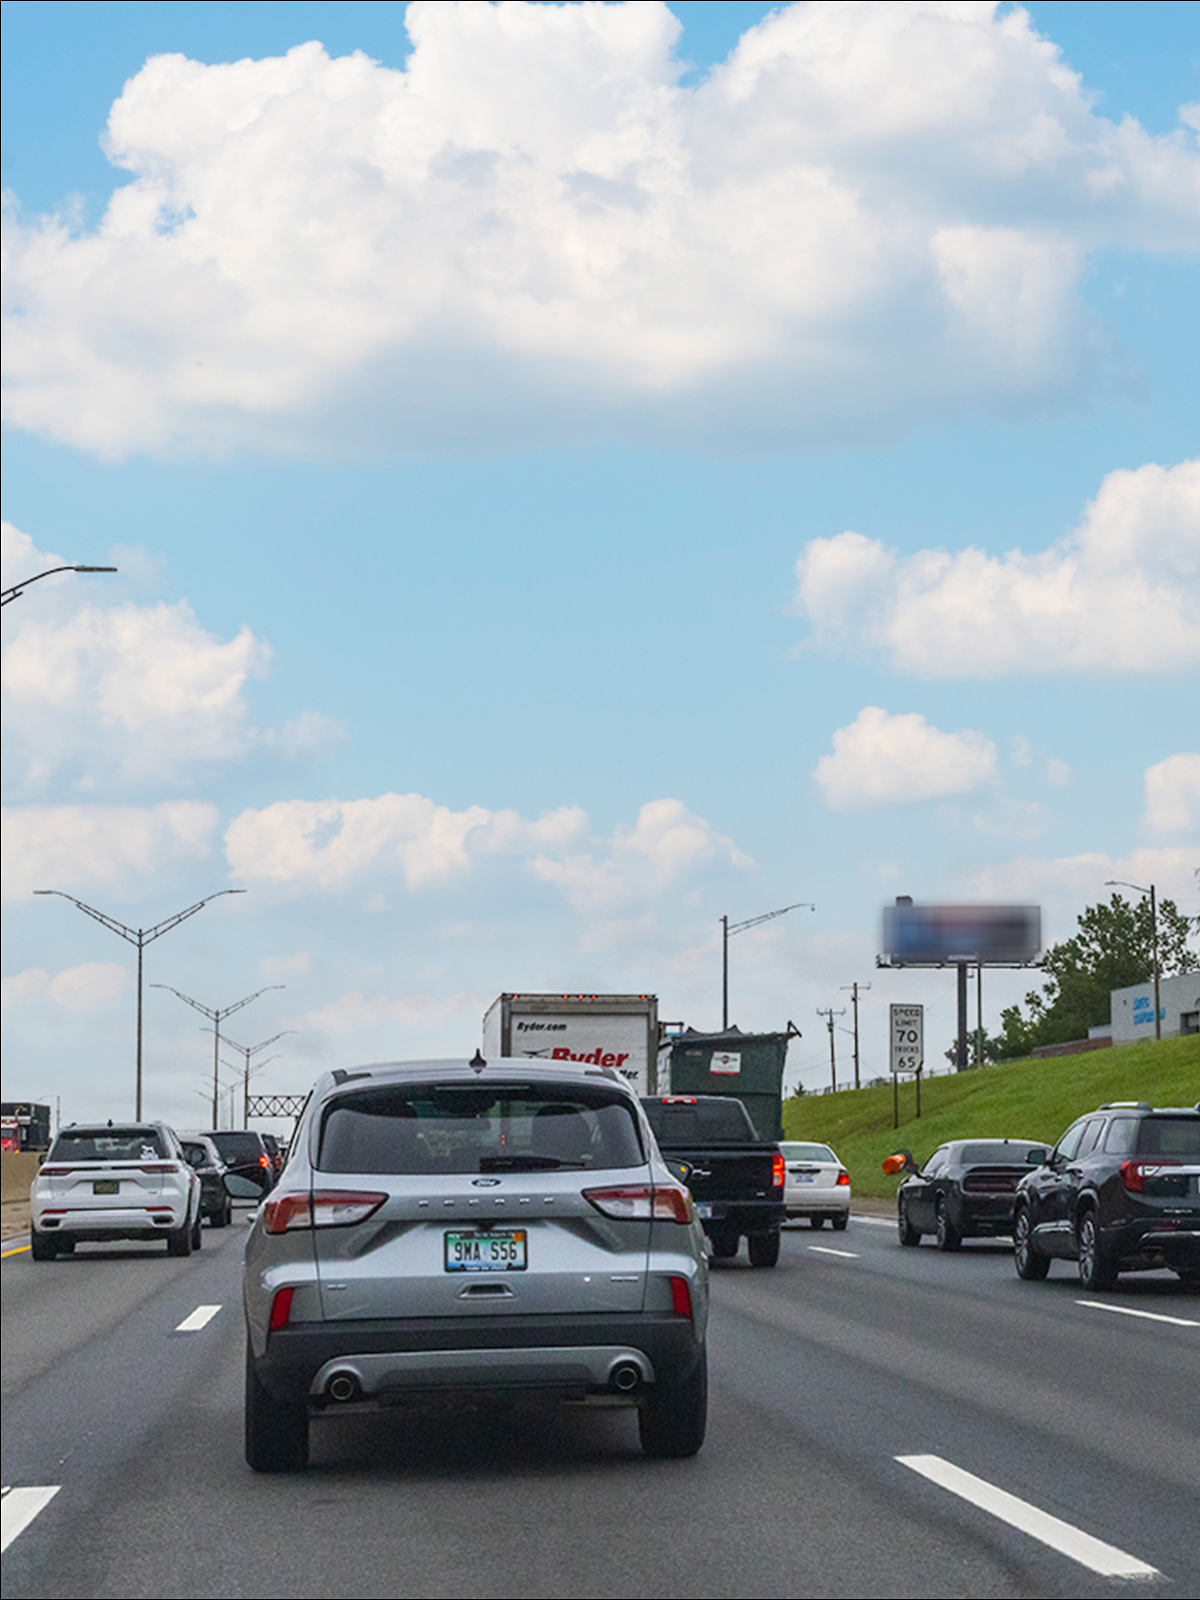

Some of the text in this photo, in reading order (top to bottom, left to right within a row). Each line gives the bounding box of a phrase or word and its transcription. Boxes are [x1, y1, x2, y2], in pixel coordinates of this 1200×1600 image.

[893, 1008, 920, 1017] SPEED
[517, 1022, 567, 1032] Ryder.com
[896, 1030, 918, 1043] 70
[894, 1046, 919, 1054] TRUCKS
[898, 1056, 916, 1068] 65
[454, 1241, 518, 1261] 9MA S56
